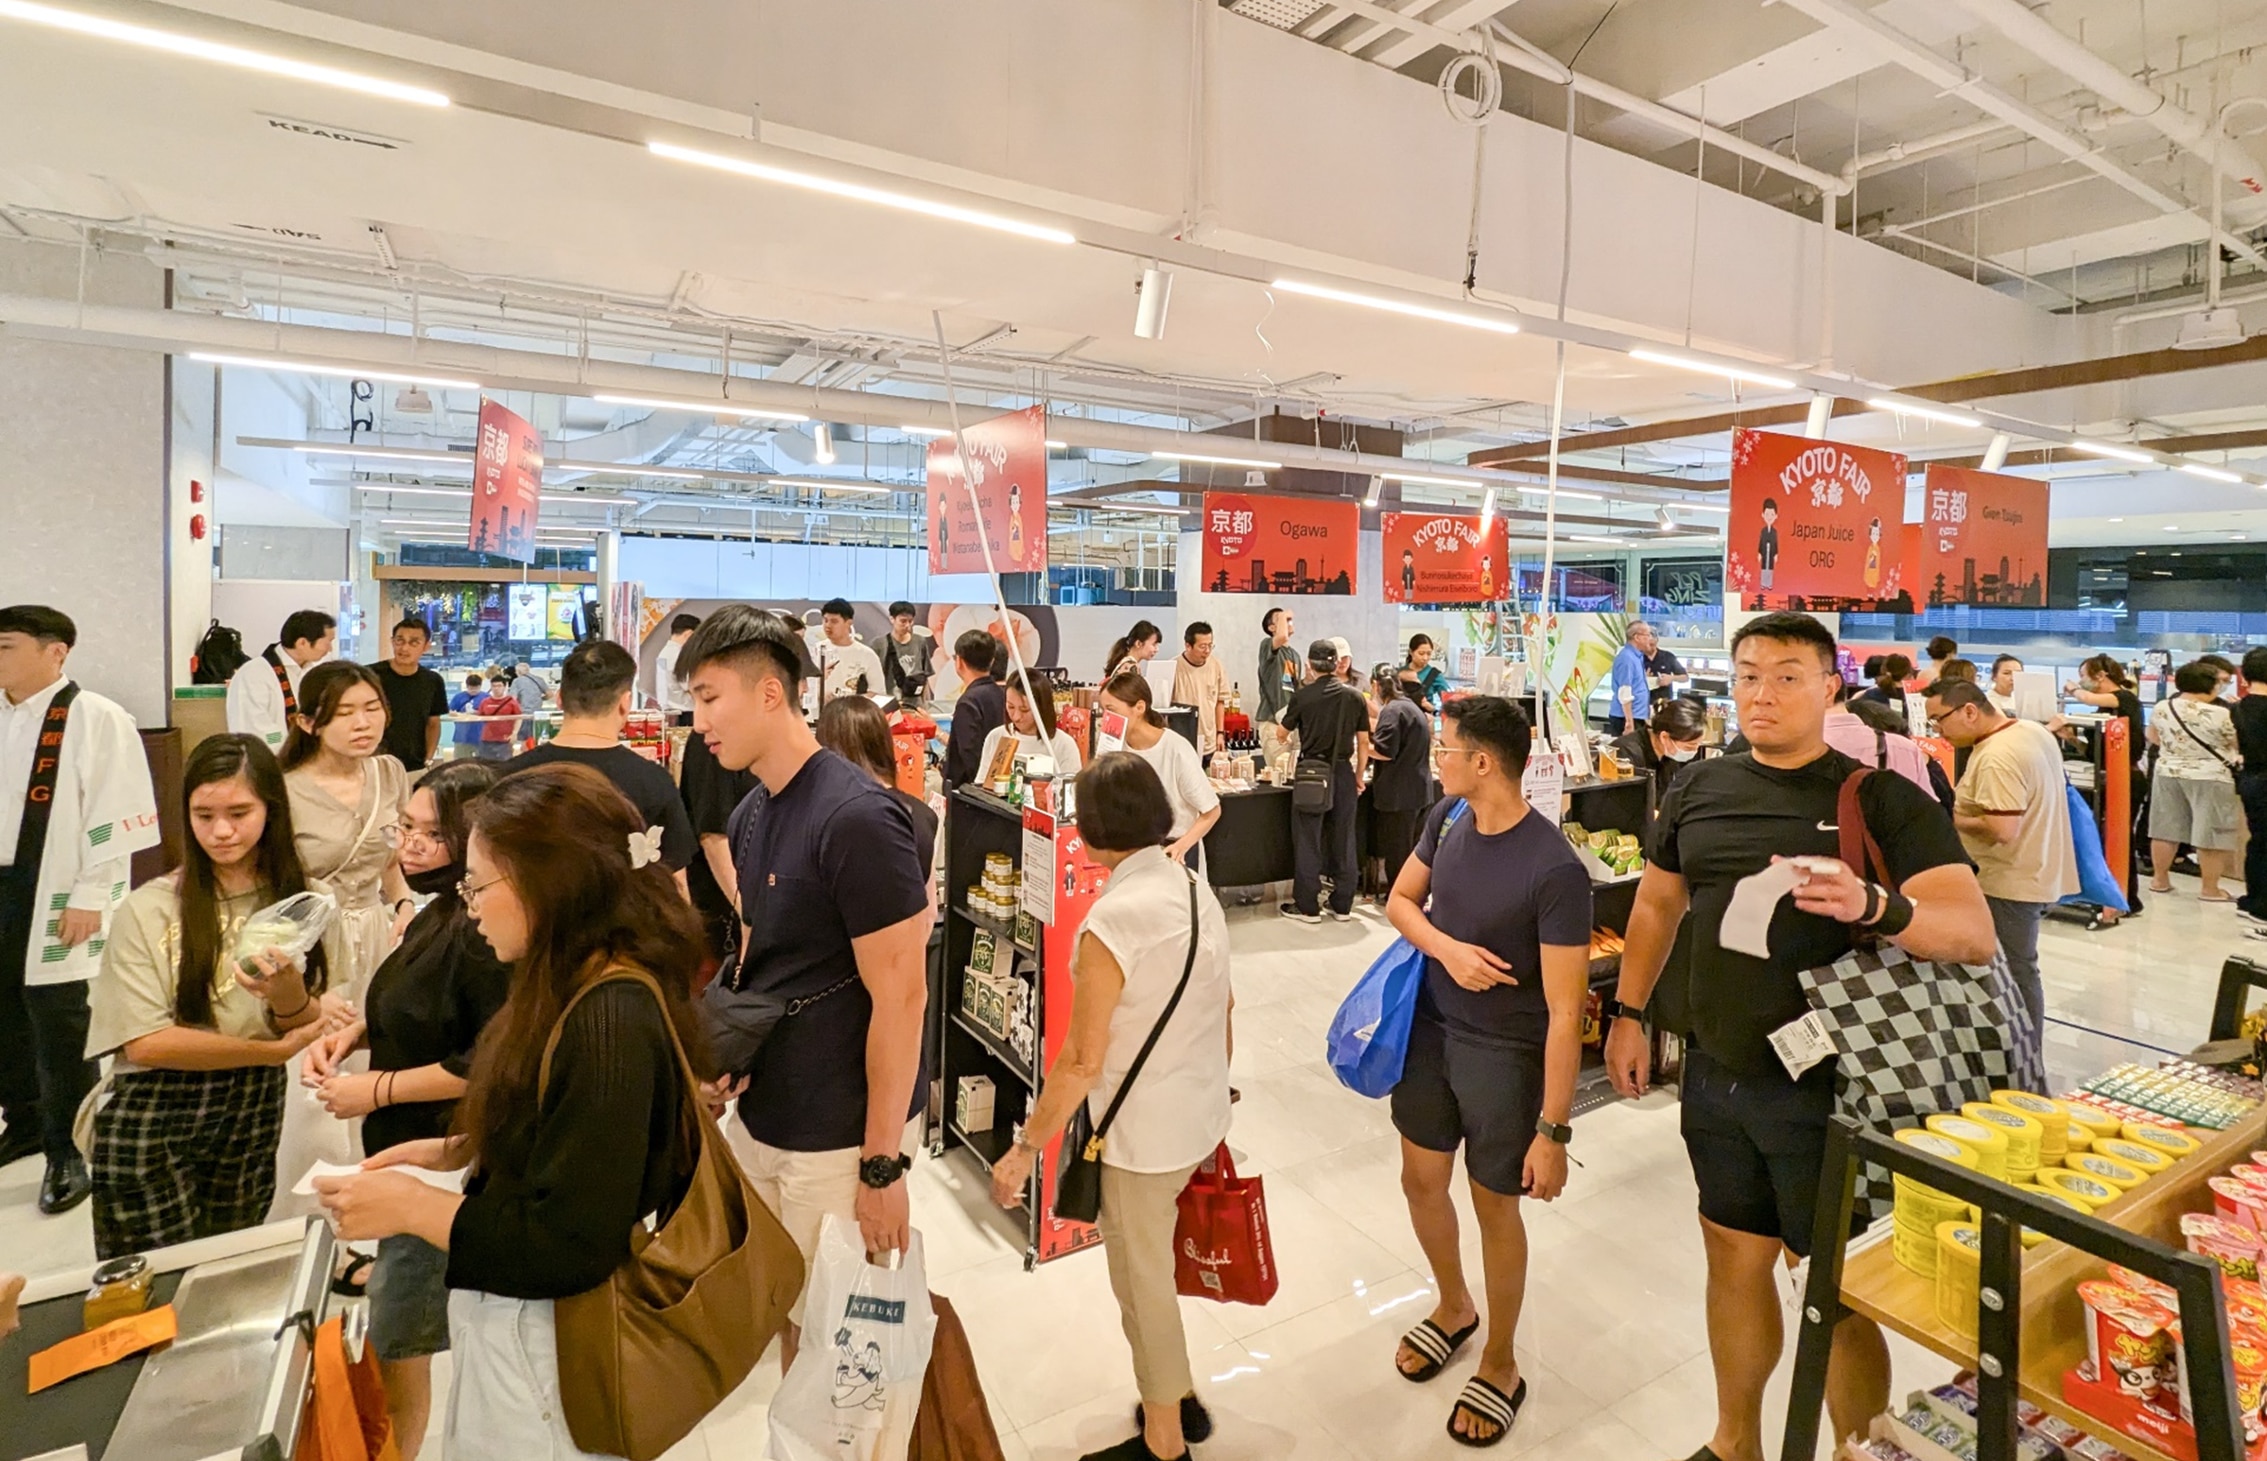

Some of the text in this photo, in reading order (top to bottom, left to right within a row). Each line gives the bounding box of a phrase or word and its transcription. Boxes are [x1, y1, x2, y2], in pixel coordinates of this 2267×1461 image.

[1779, 446, 1872, 505] KYOTO FAIR
[1931, 488, 1967, 523] 京都
[1211, 509, 1254, 535] 京都
[1280, 520, 1328, 540] Ogawa
[1412, 518, 1481, 549] KYOTO FAIR
[1791, 520, 1855, 542] Japan Juice
[1809, 550, 1835, 569] ORG
[2136, 1412, 2170, 1435] meiji
